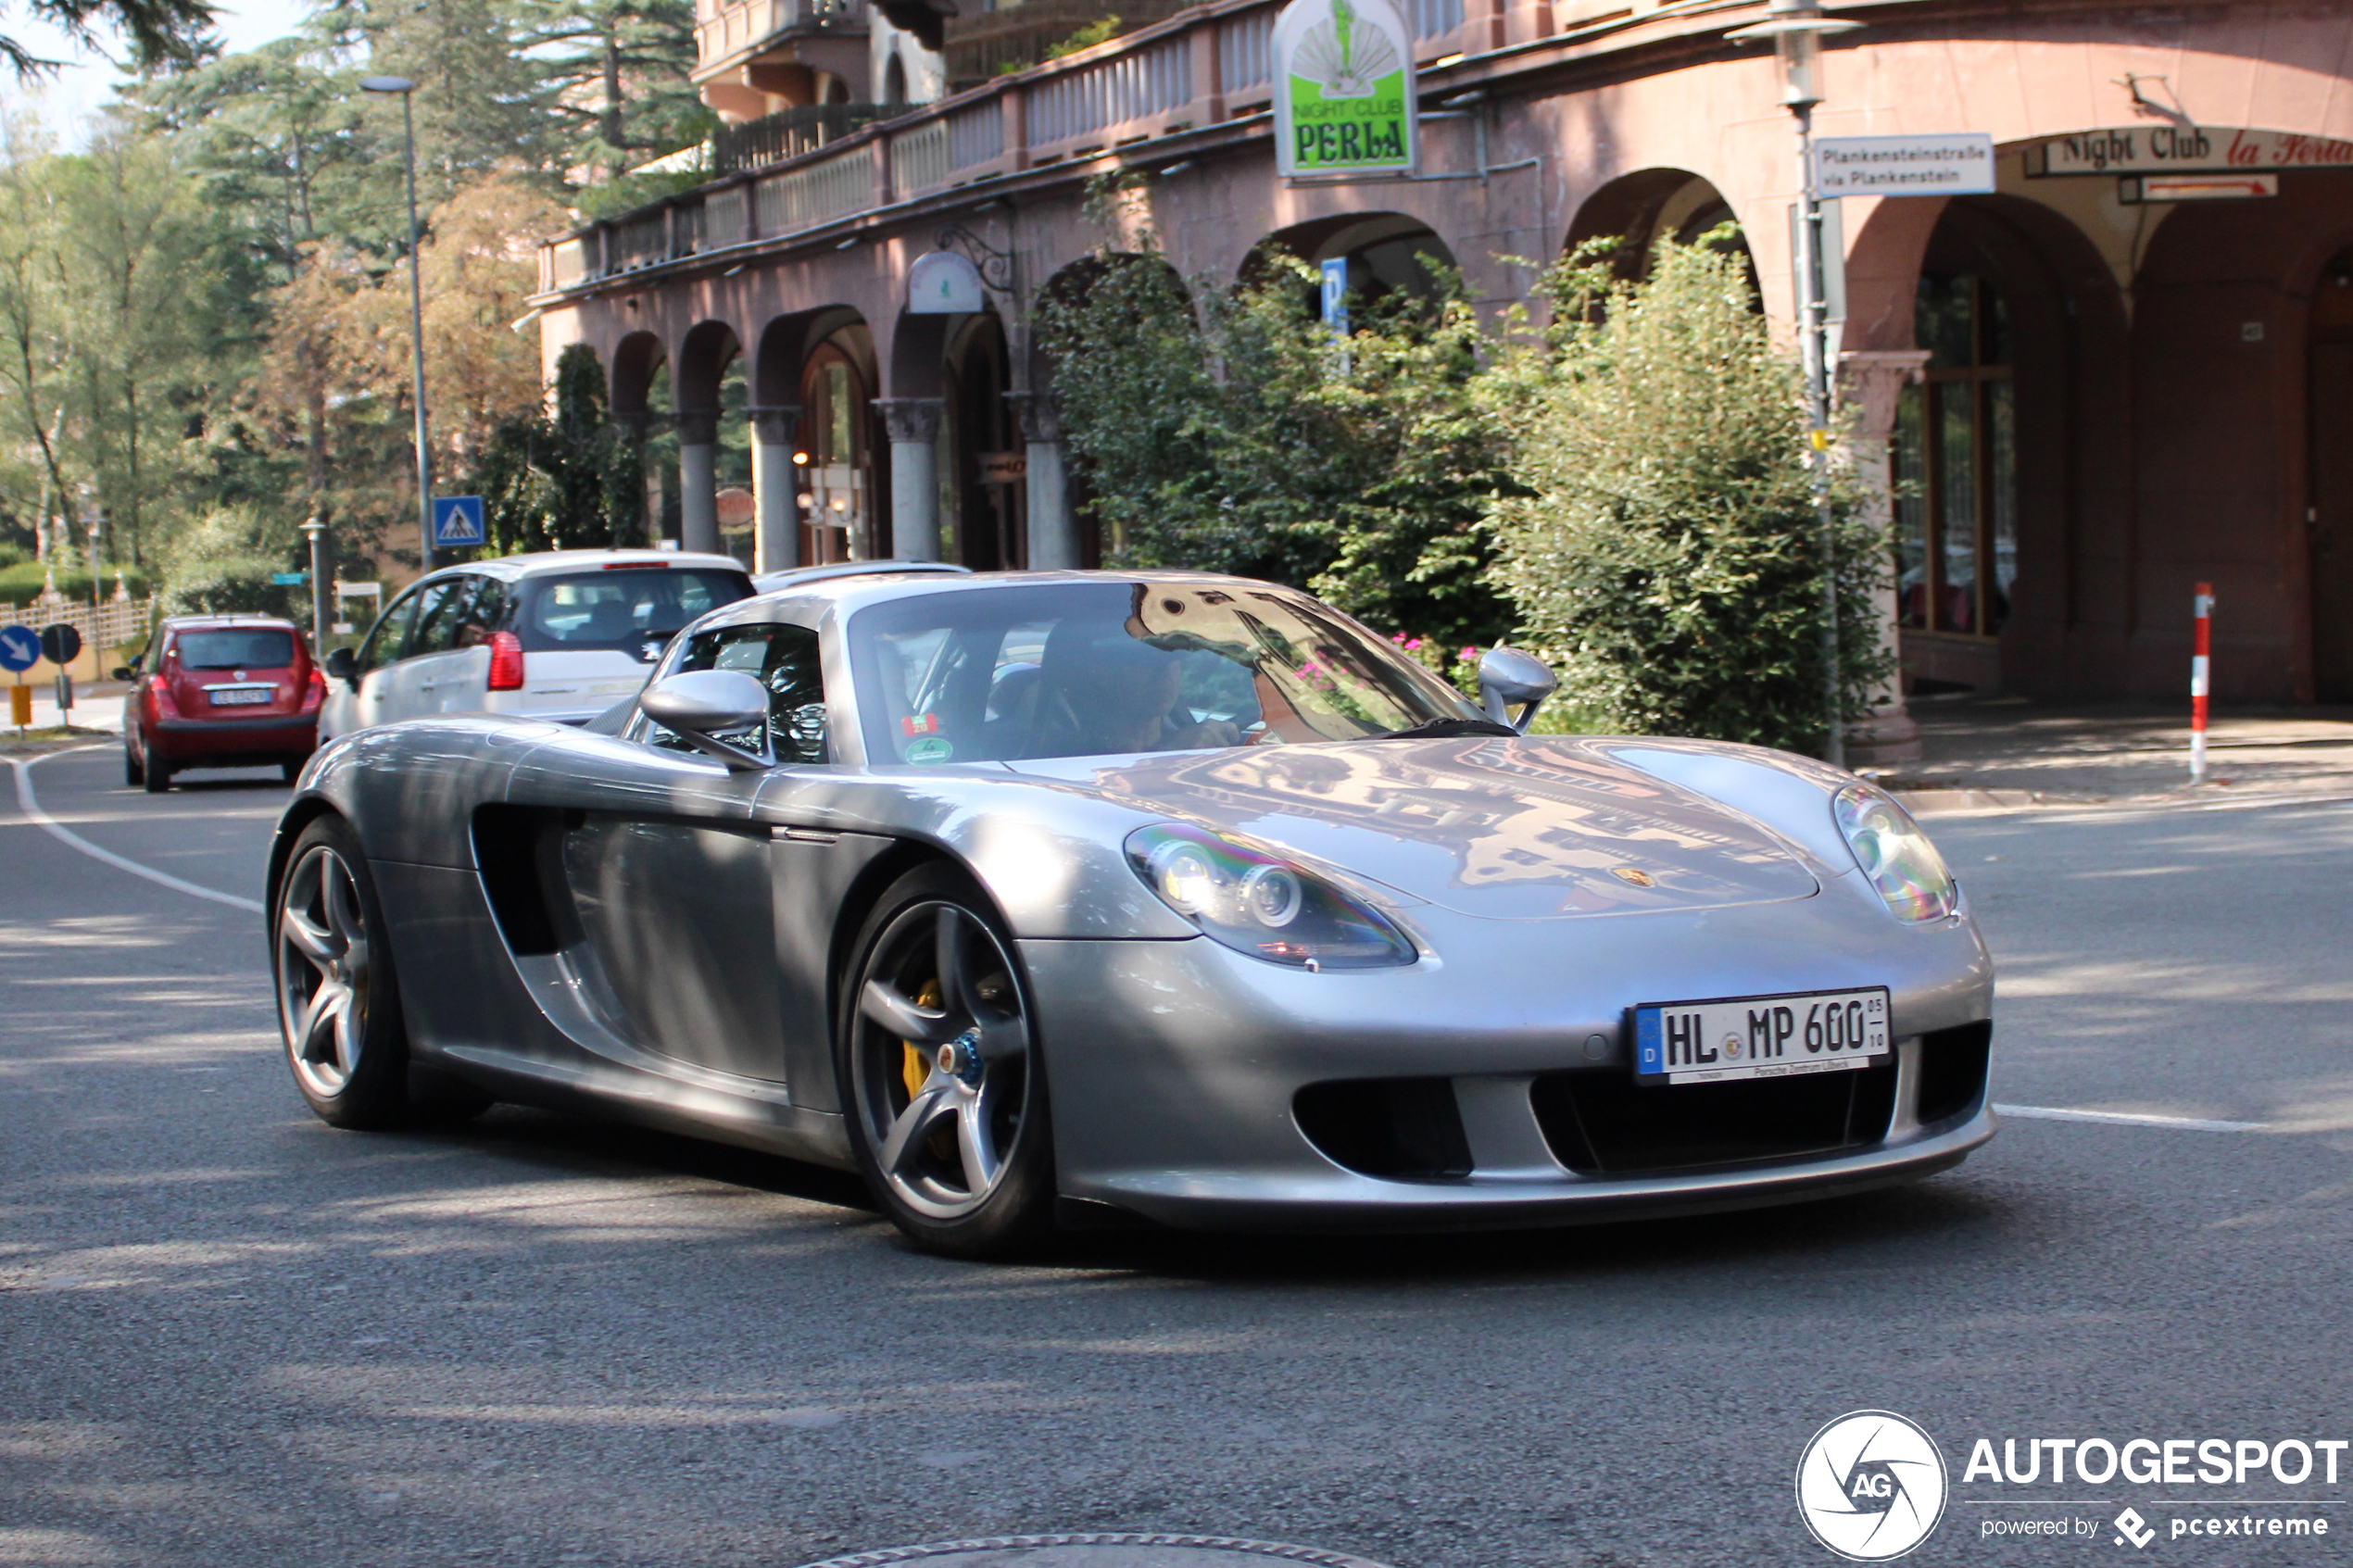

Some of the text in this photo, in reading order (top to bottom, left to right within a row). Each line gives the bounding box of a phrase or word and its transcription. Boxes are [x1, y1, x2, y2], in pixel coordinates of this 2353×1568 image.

[1293, 98, 1403, 119] NIGHT CLUB
[1295, 120, 1405, 162] PERLA
[2063, 130, 2136, 169] Night
[2151, 126, 2211, 158] Club
[2227, 130, 2259, 165] la
[1823, 144, 1985, 164] Plankensteinstraße
[1824, 168, 1959, 186] via Plankenstein
[1326, 269, 1341, 322] P
[1868, 998, 1882, 1012] 05
[1667, 1000, 1864, 1065] HL MP 600
[1869, 1035, 1883, 1047] 10
[1644, 1048, 1655, 1063] D
[1755, 1063, 1788, 1076] Porsche
